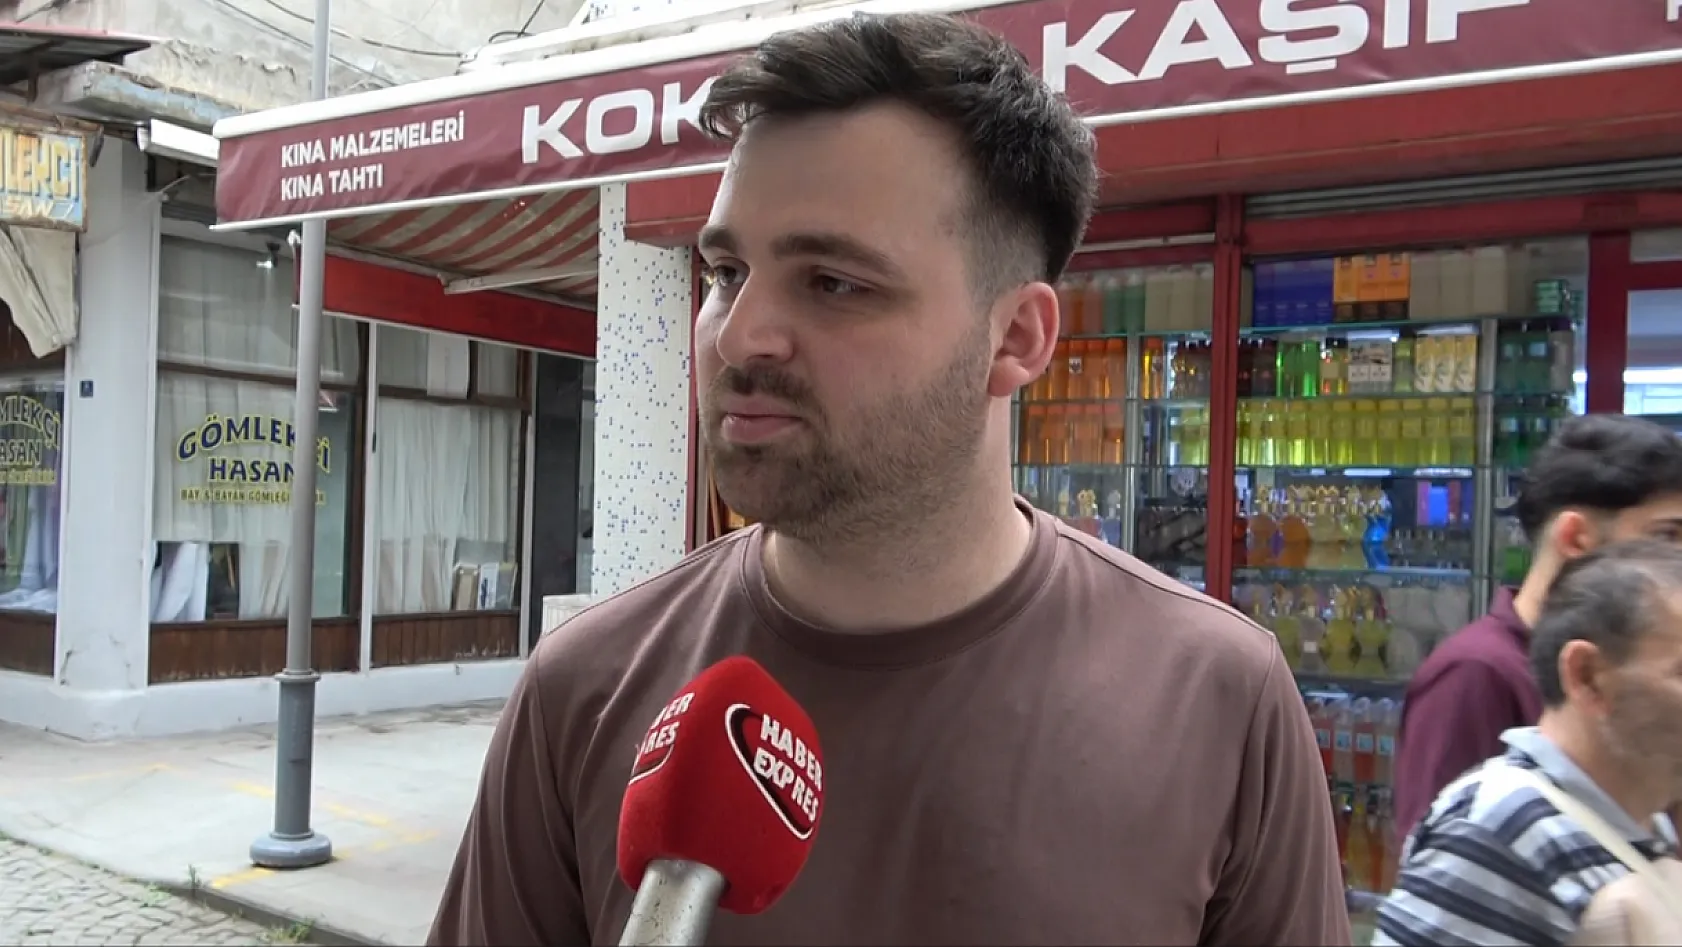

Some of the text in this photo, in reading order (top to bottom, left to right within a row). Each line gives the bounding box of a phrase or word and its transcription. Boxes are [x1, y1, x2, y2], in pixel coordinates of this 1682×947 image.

[281, 110, 465, 168] KINA MALZEMELERİ
[522, 75, 722, 164] KOK
[281, 163, 384, 201] KINA TAHTI
[177, 413, 330, 474] GÖMLEKİ
[753, 746, 820, 824] EXPRES
[760, 713, 823, 792] HABER
